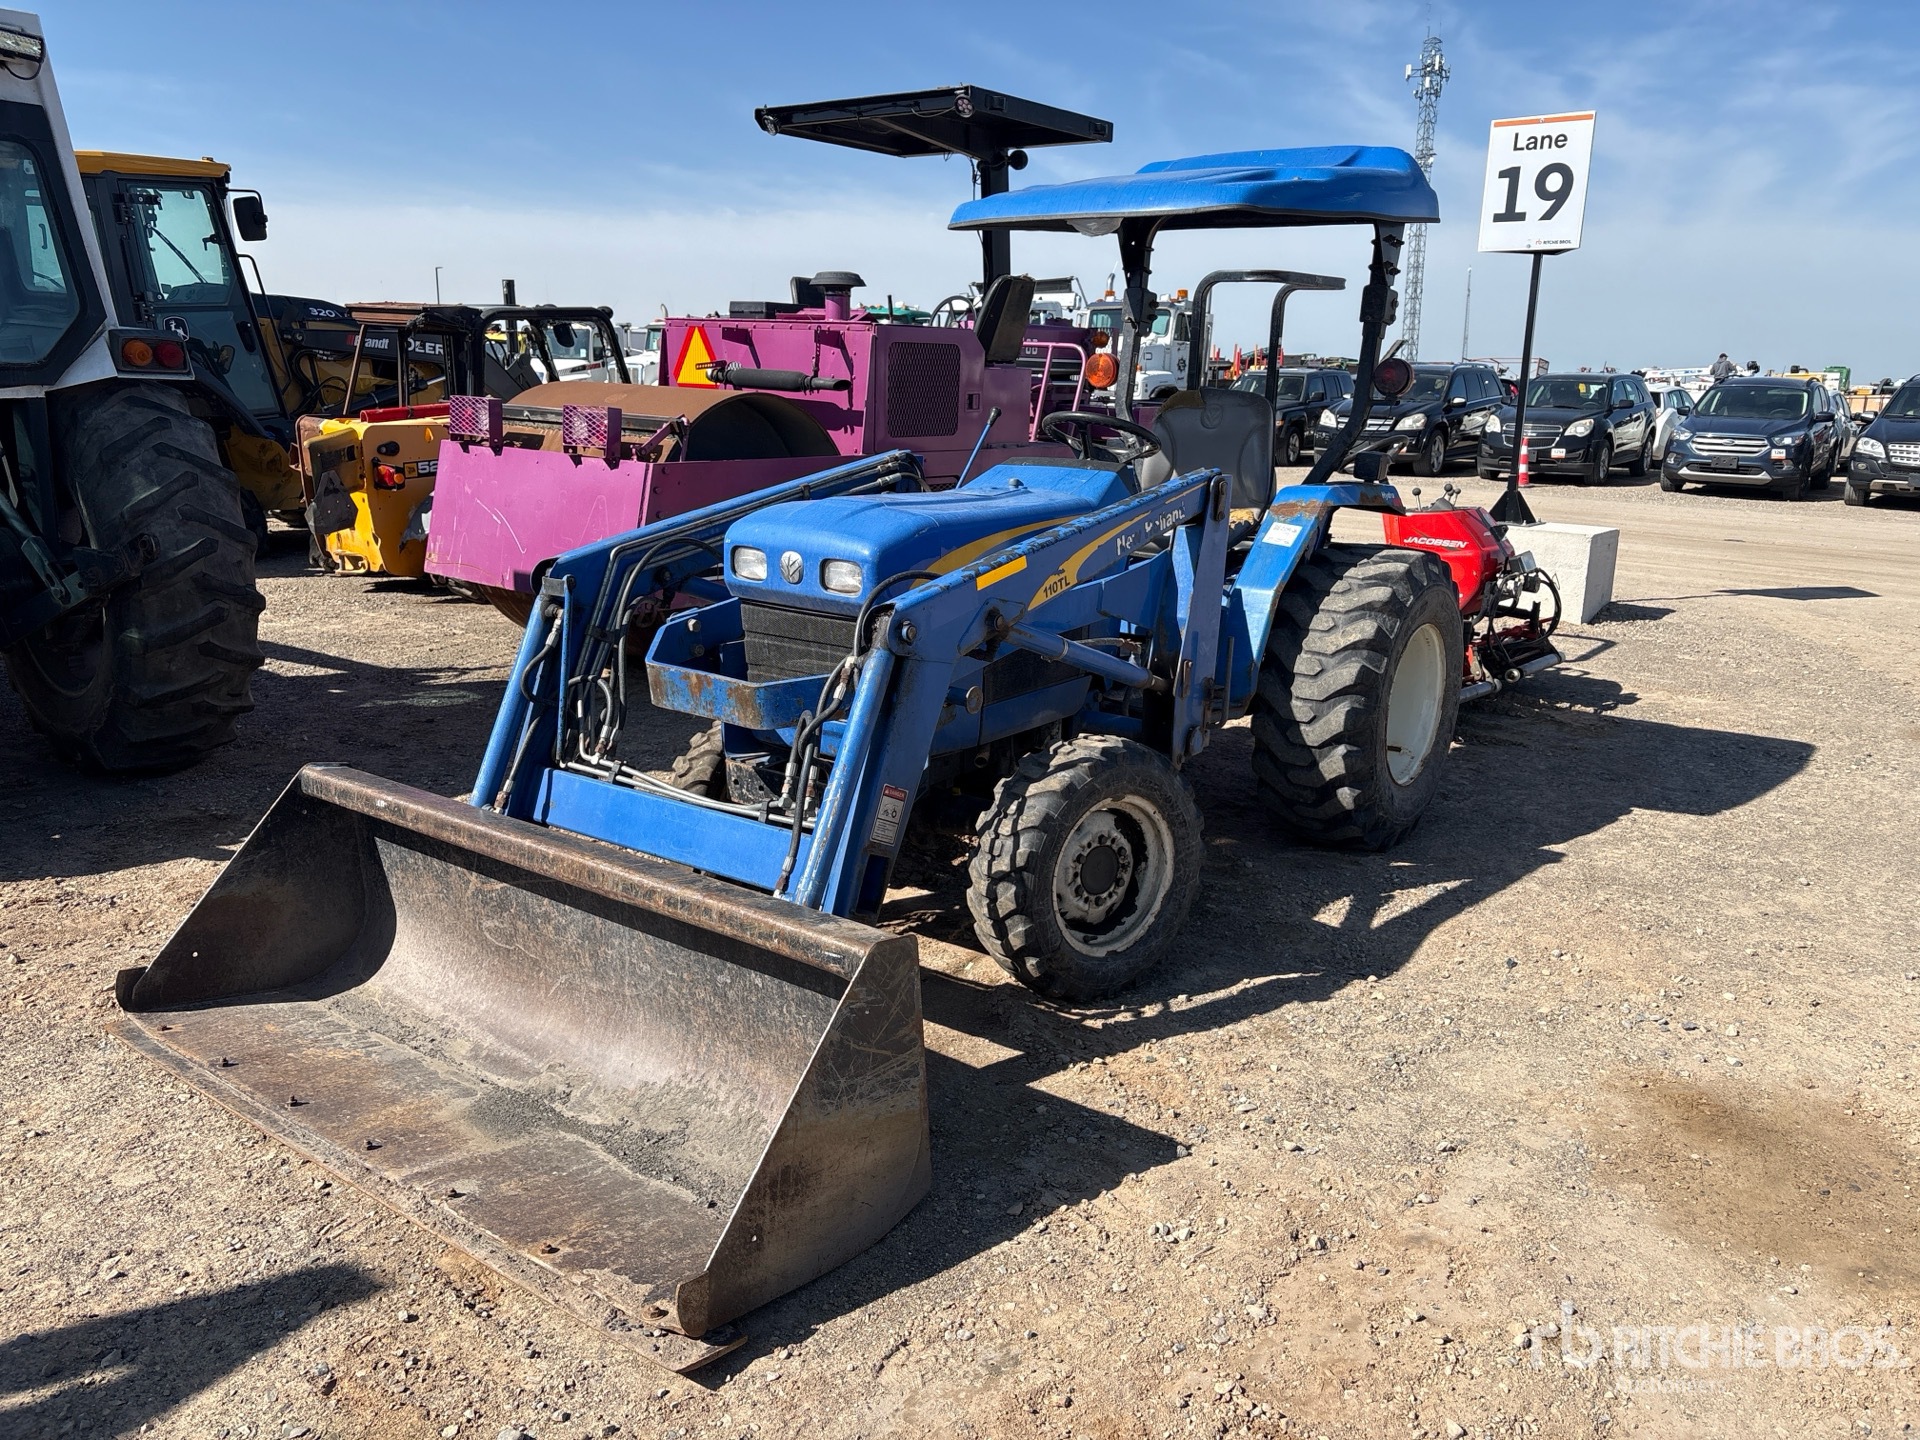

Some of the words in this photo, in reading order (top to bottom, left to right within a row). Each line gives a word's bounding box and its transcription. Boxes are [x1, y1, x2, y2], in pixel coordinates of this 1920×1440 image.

[1513, 132, 1568, 151] Lane
[1493, 162, 1574, 223] 19
[1404, 536, 1469, 549] JACOBSEN
[1043, 576, 1071, 599] 110TL
